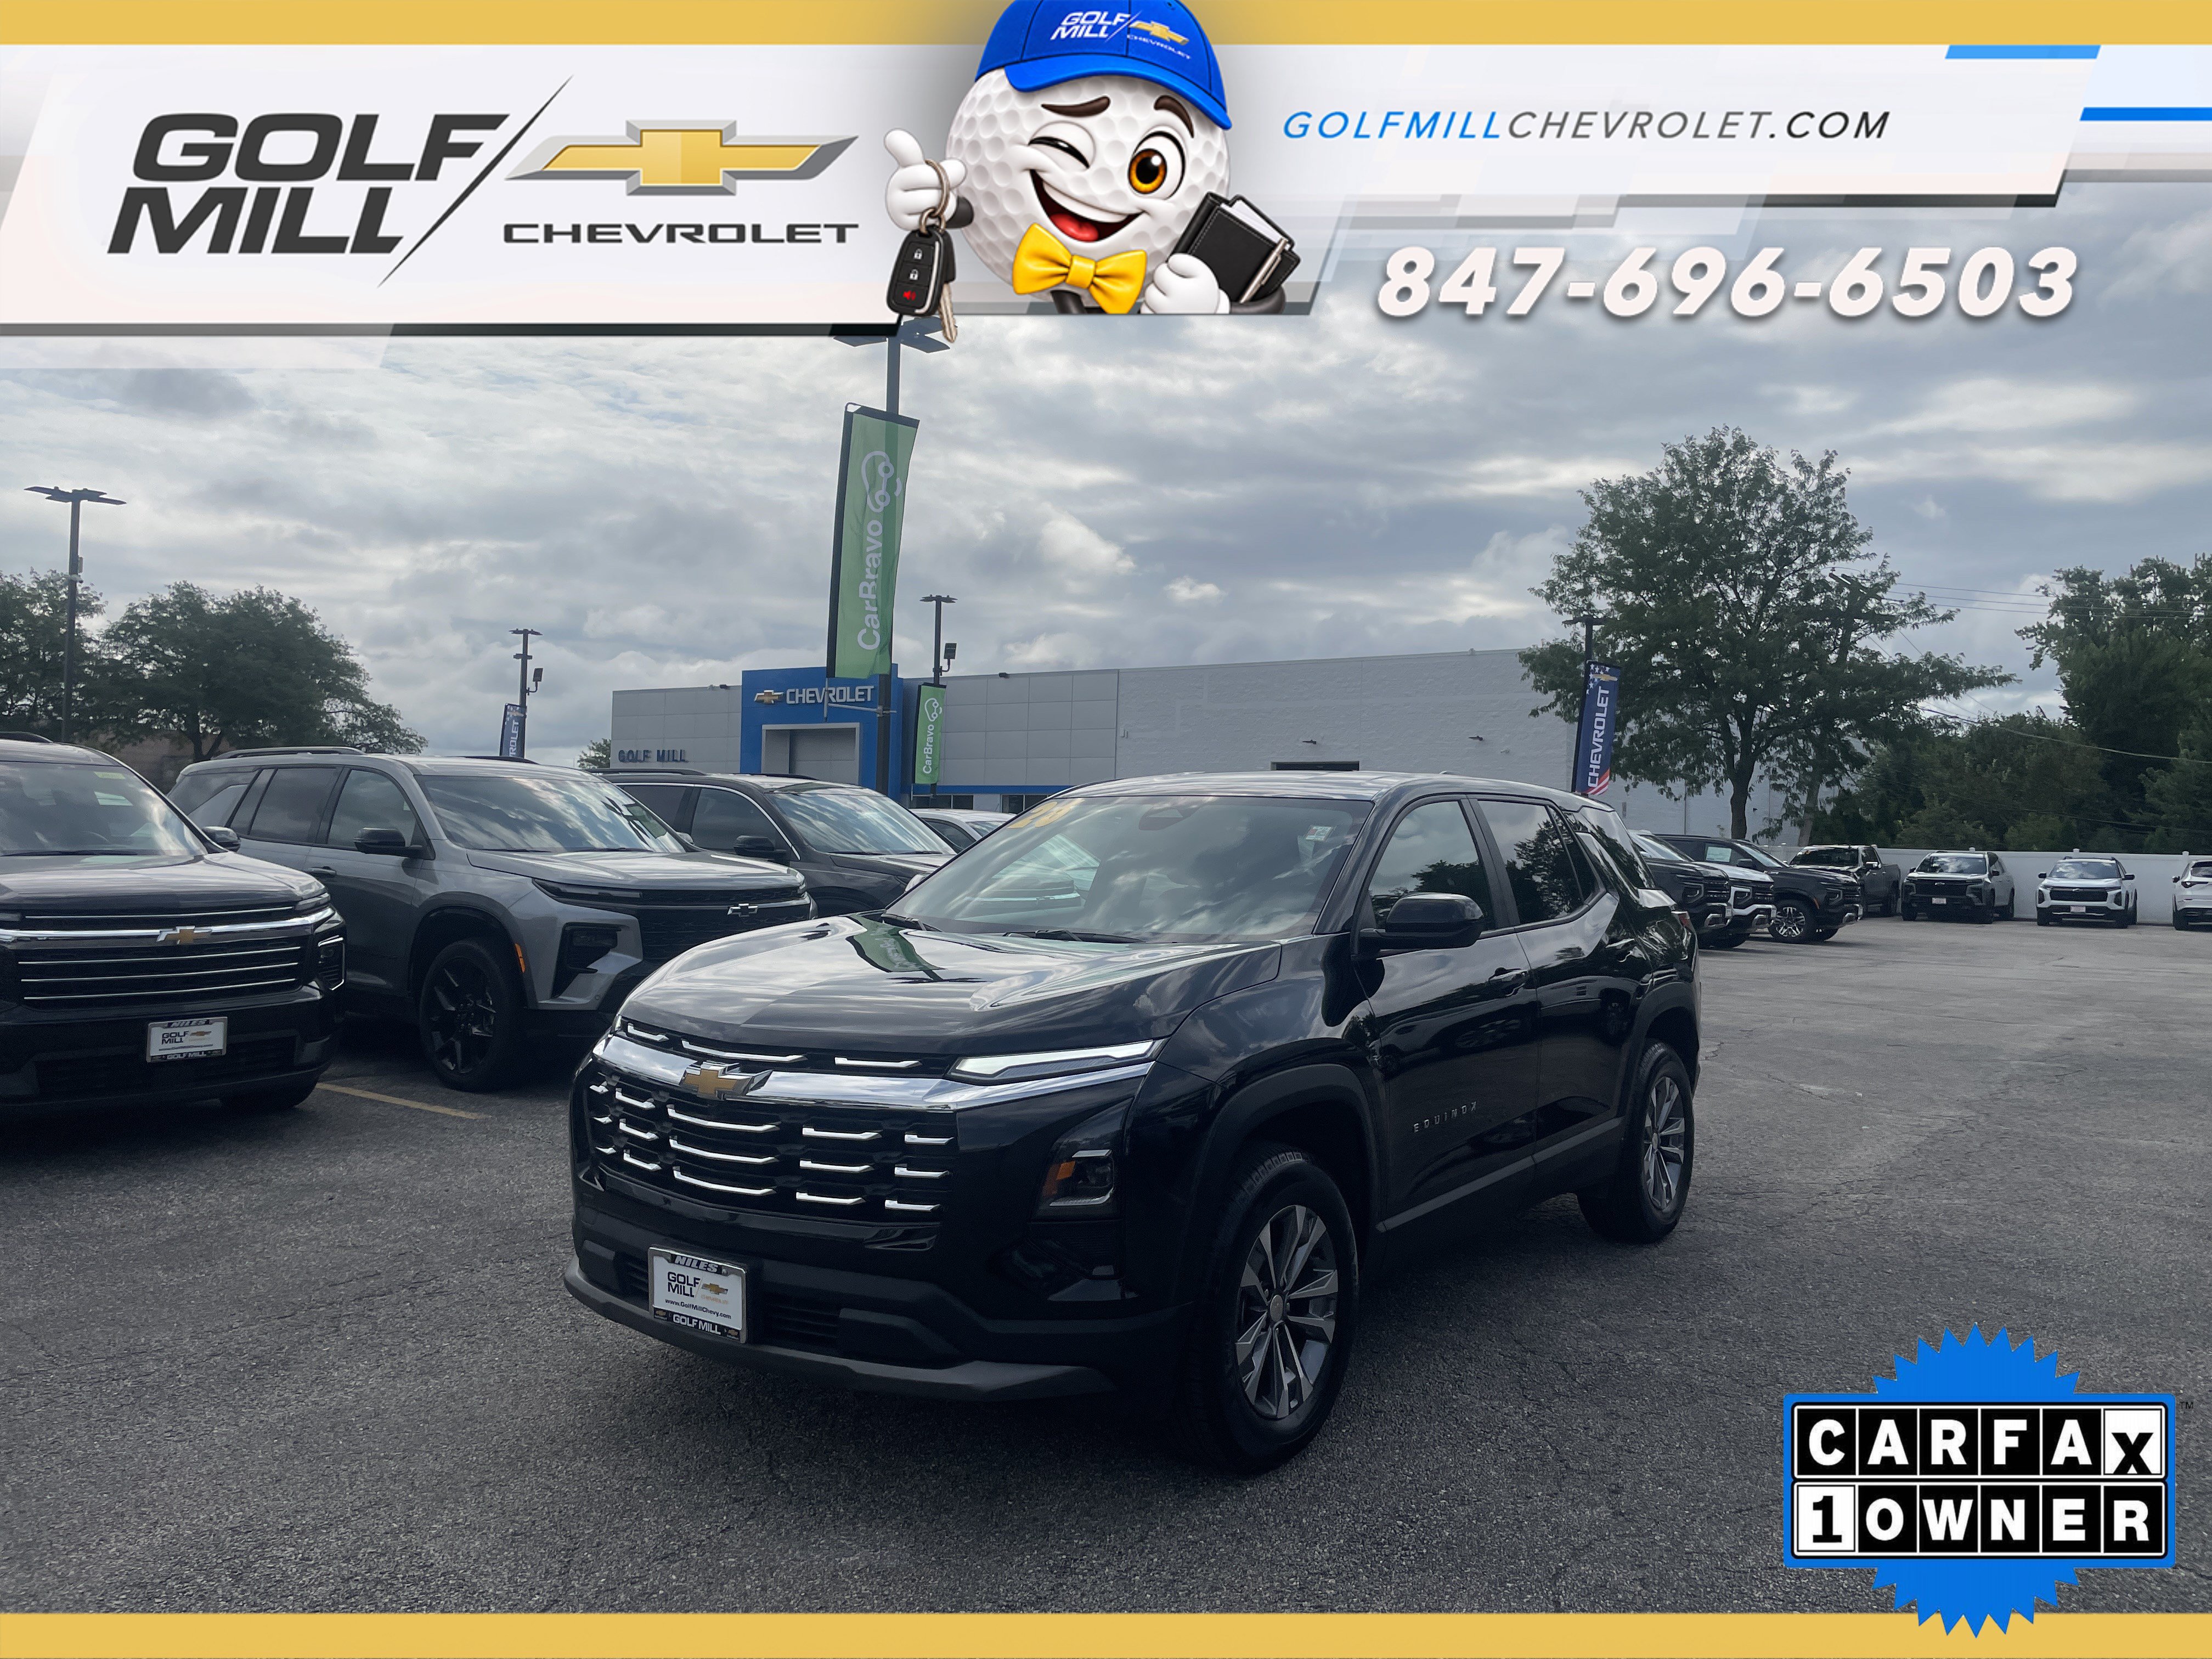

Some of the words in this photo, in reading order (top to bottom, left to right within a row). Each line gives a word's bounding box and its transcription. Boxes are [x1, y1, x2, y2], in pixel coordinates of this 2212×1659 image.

[857, 520, 883, 650] CarBravo
[786, 686, 874, 704] CHEVROLET
[509, 719, 519, 757] ROLET
[1588, 686, 1609, 788] CHEVROLET
[618, 749, 651, 763] GOLF
[657, 749, 687, 763] MILL
[923, 724, 934, 774] CarBravo
[675, 1256, 718, 1273] NILES
[667, 1272, 701, 1288] GOLF
[668, 1282, 695, 1298] MILL
[665, 1299, 731, 1319] www.GolfMillChevy.com
[673, 1314, 698, 1328] GOLF
[698, 1321, 721, 1335] MILL
